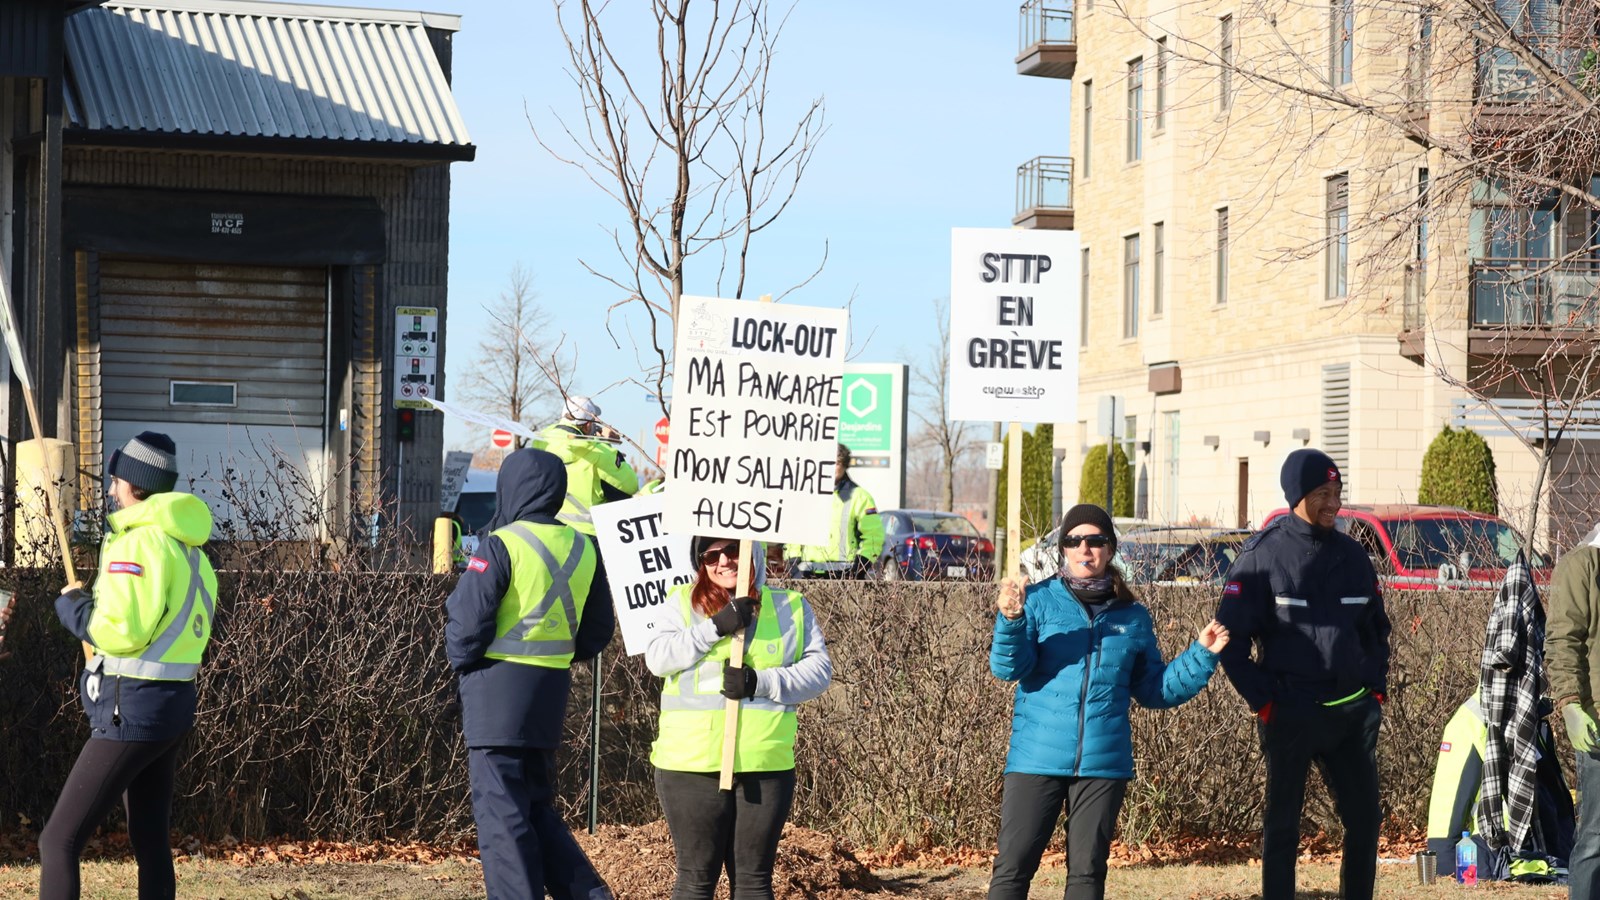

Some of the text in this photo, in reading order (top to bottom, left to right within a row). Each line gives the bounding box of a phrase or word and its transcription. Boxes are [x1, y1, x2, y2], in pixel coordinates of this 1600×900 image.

[979, 252, 1052, 284] STTP
[997, 296, 1033, 326] EN
[732, 317, 837, 358] LOCK-OUT
[967, 331, 1062, 370] GRÈVE
[687, 356, 843, 407] MA PANCARTE
[841, 421, 882, 432] Desjardins
[639, 546, 672, 574] EN
